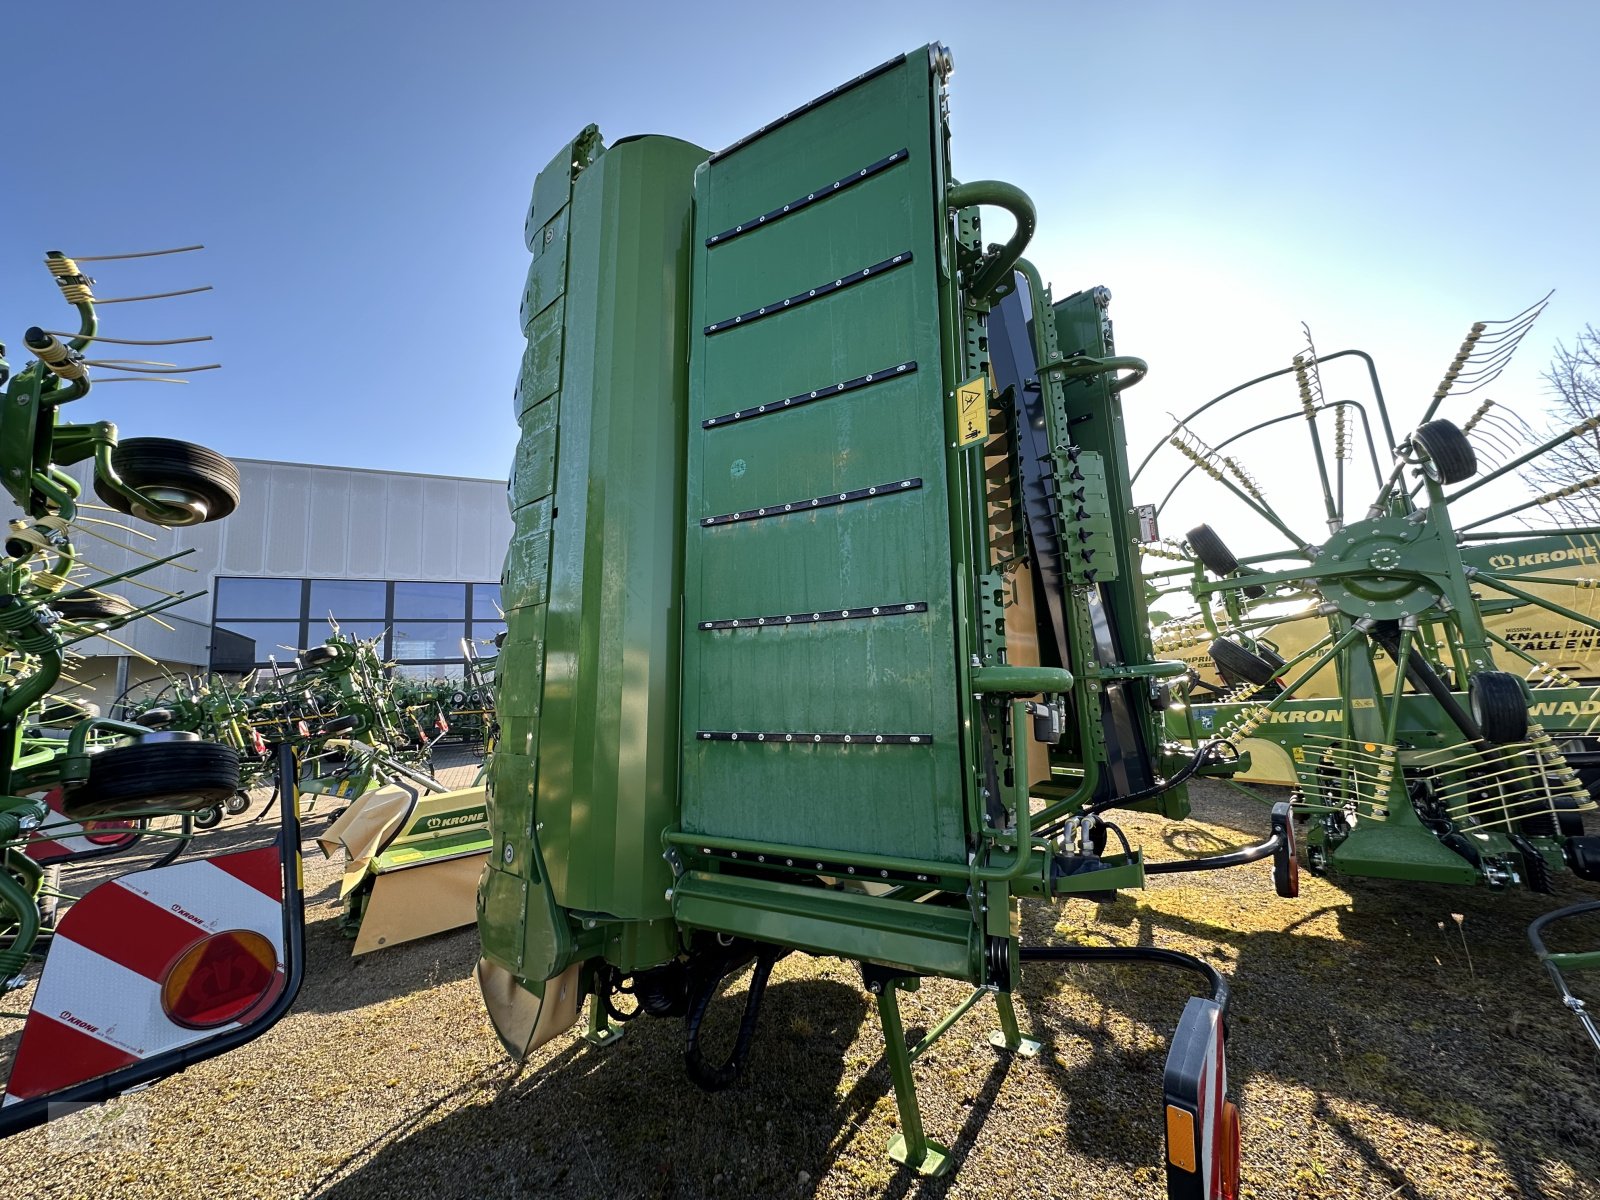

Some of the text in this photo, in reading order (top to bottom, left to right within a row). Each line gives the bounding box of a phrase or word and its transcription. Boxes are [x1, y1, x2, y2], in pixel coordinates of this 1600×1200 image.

[1518, 546, 1597, 566] KRONE
[1270, 709, 1343, 723] KRON
[1528, 700, 1600, 716] WAD
[442, 813, 484, 826] KRONE
[178, 908, 204, 925] KRONE
[67, 1016, 99, 1033] KRONE
